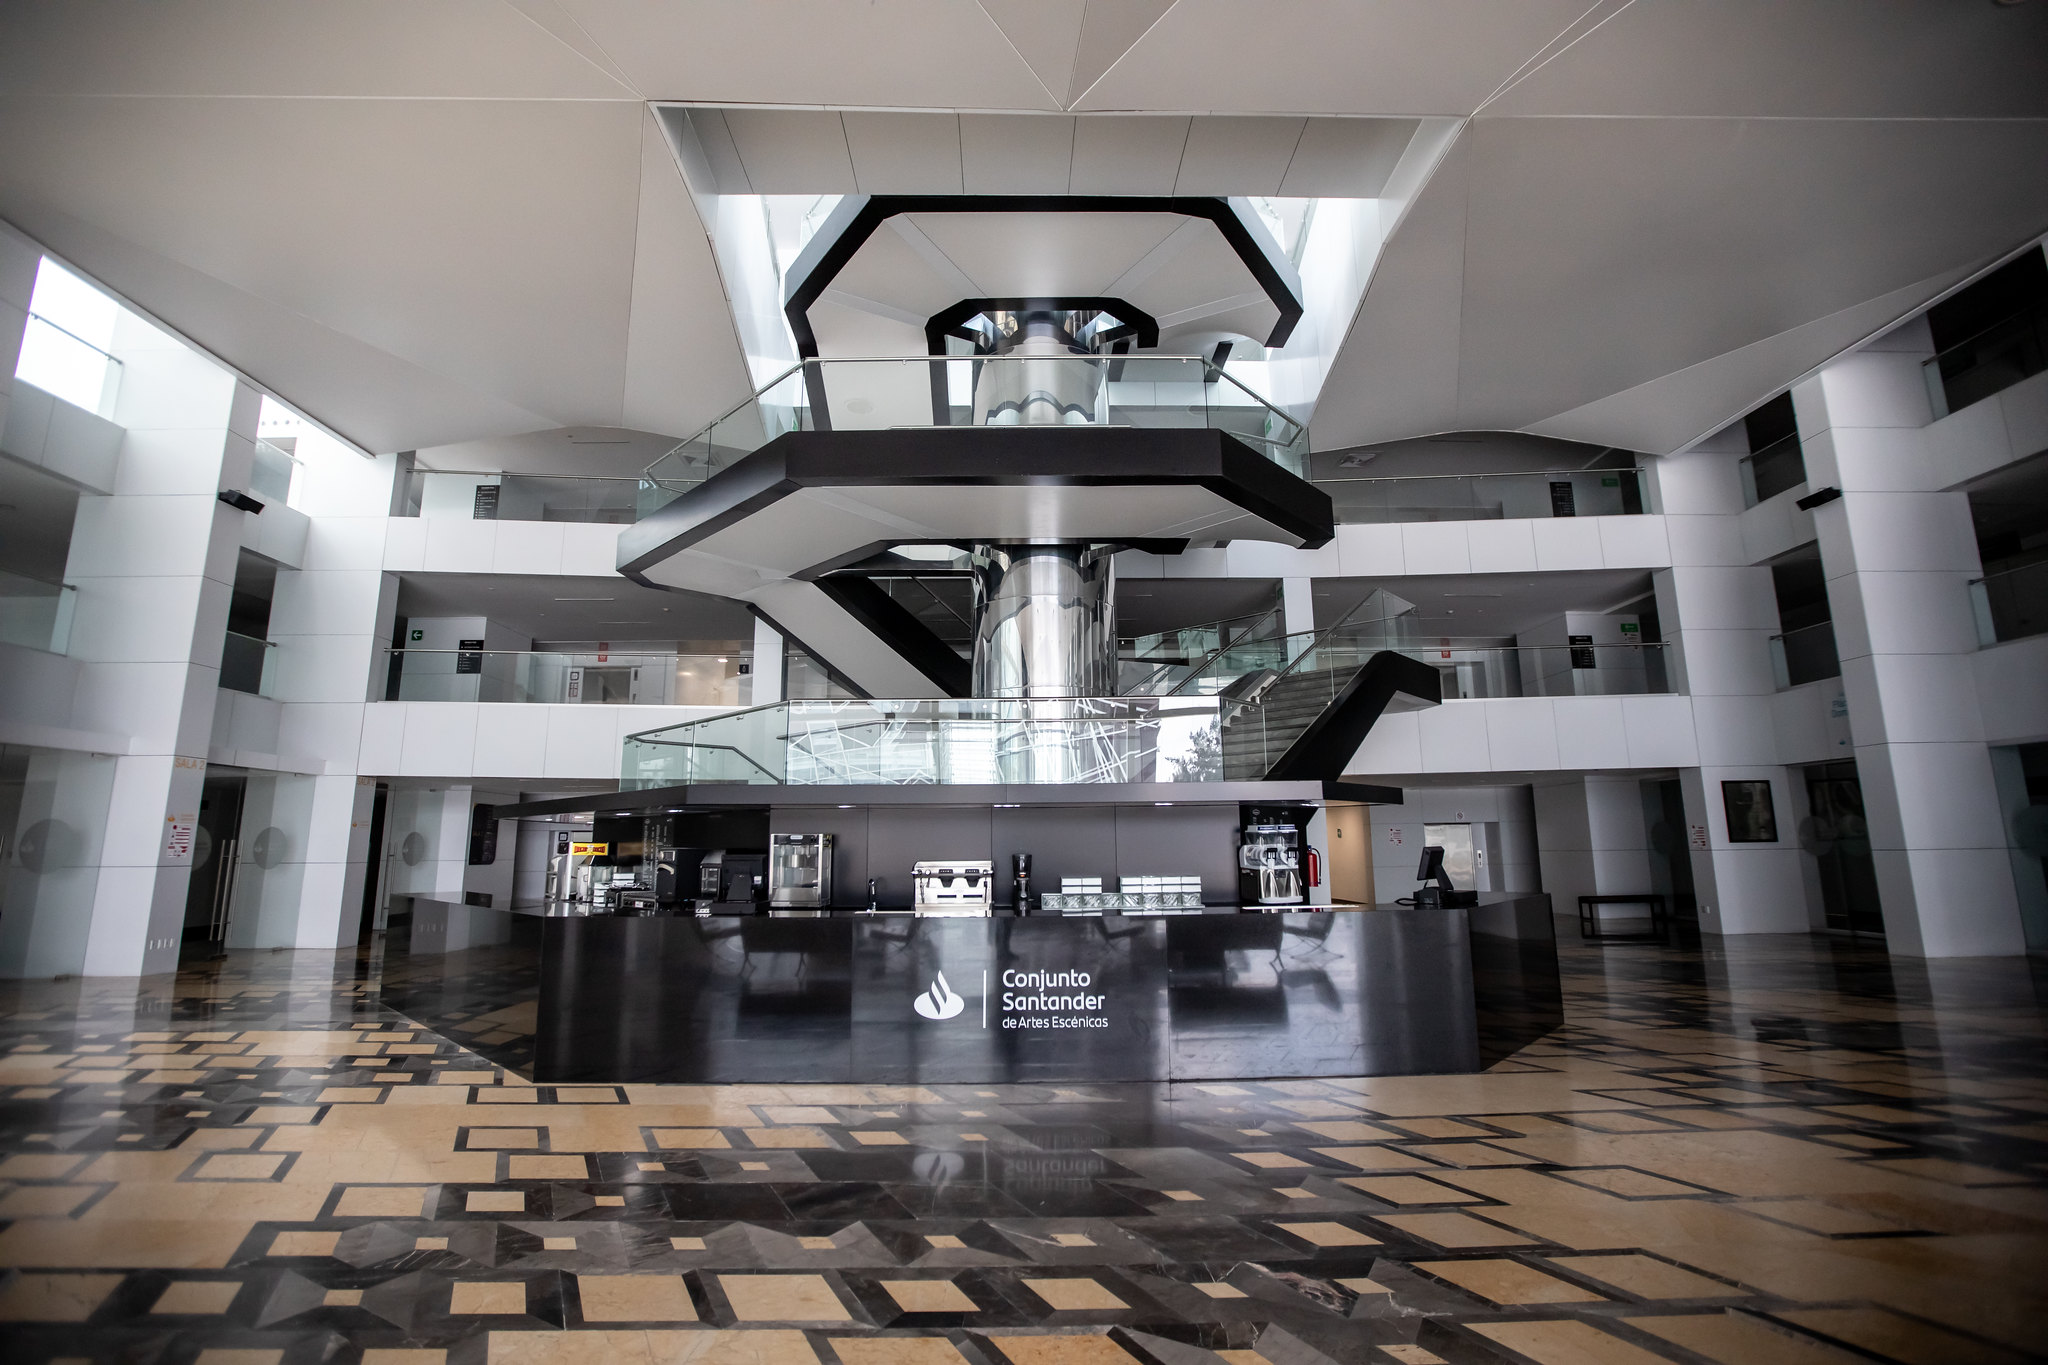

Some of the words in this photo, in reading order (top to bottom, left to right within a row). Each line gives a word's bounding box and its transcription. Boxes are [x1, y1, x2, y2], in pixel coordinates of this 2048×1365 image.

[175, 757, 197, 769] SALA
[199, 759, 205, 770] 2
[1002, 968, 1091, 992] Conjunto
[1002, 992, 1106, 1011] Santander
[1002, 1016, 1017, 1029] de
[1017, 1016, 1050, 1029] Artes
[1051, 1015, 1109, 1028] Escénicas
